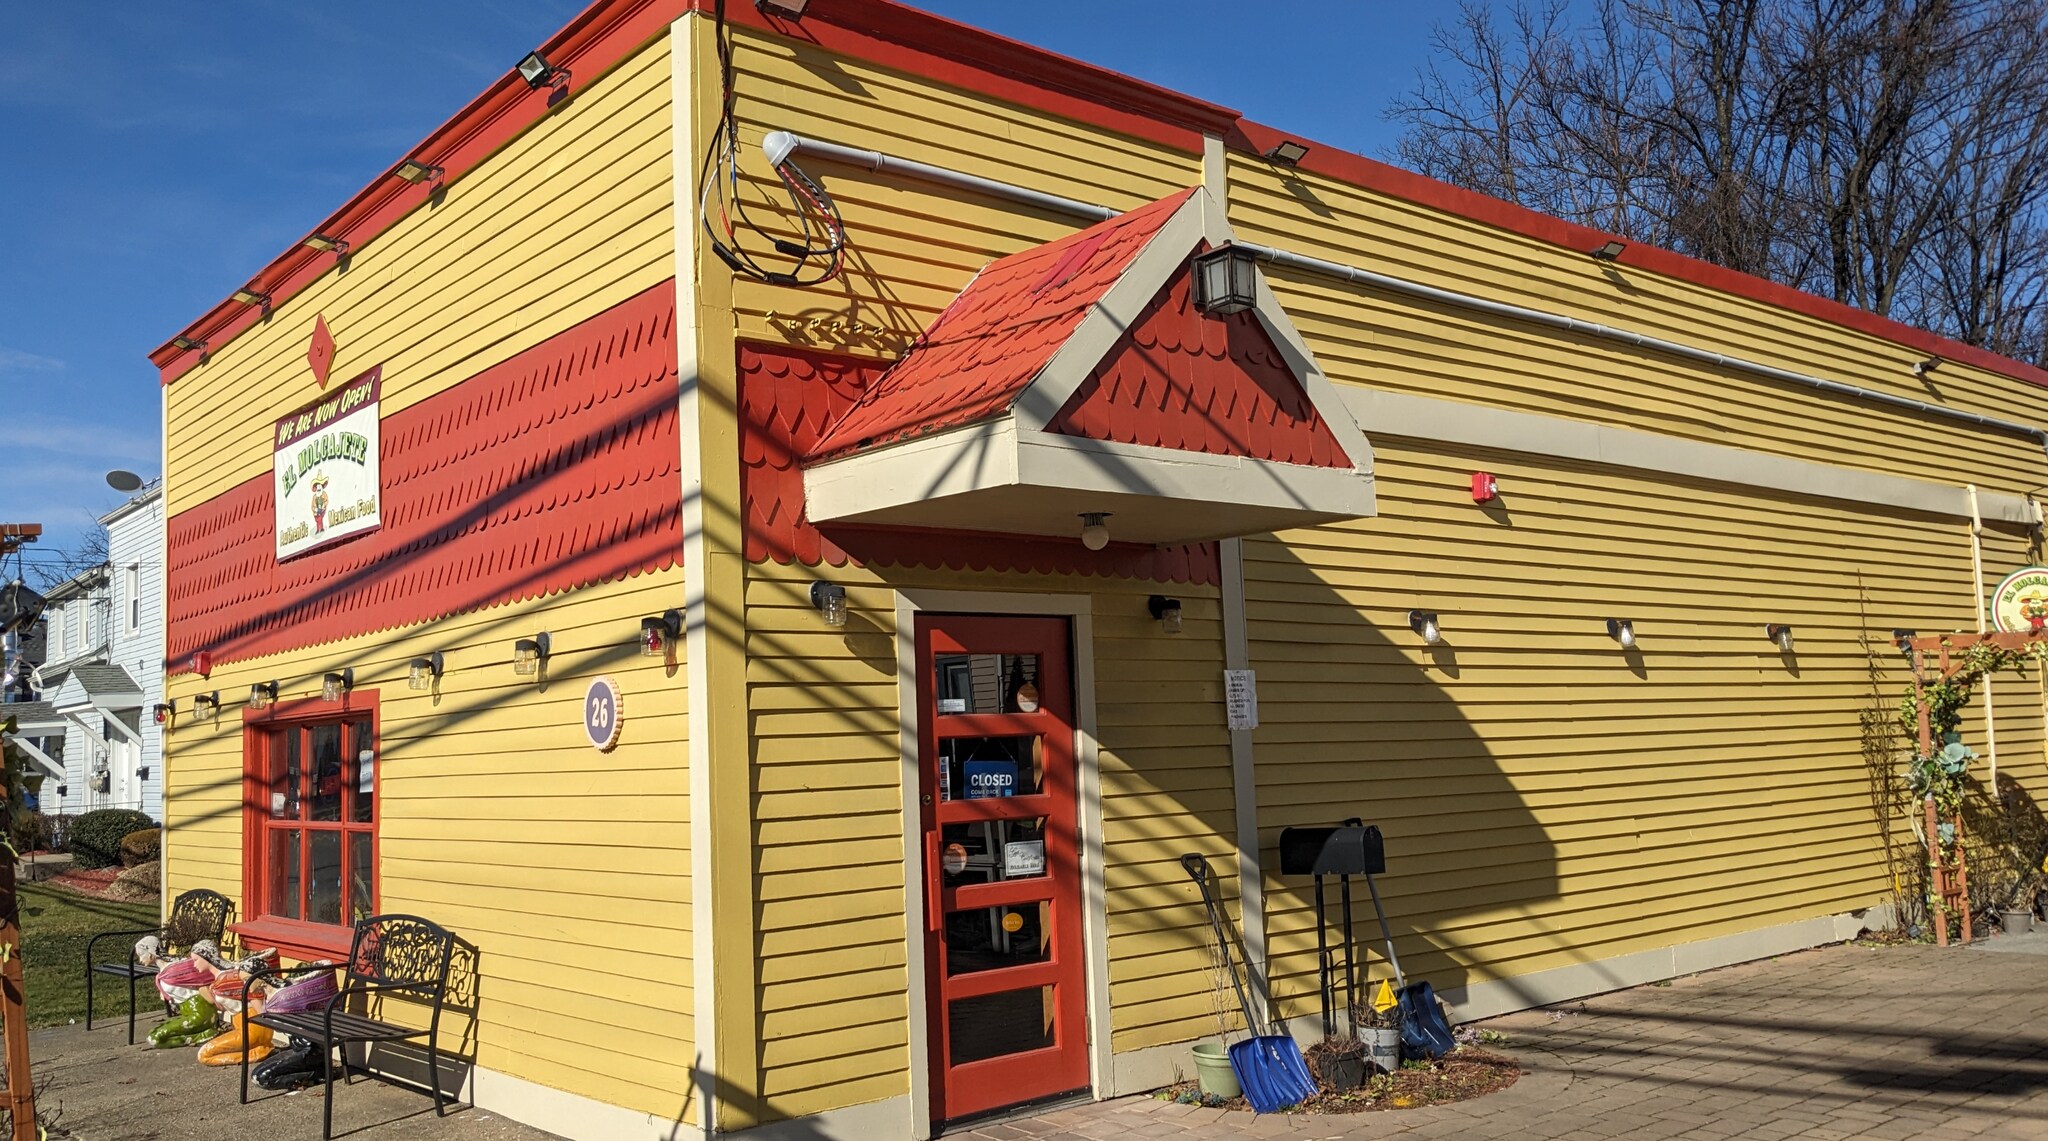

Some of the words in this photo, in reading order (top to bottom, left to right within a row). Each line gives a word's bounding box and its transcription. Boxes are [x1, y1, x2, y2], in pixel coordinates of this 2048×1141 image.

[282, 464, 297, 498] EL
[298, 432, 368, 478] MOLCAJETE
[280, 520, 309, 547] Authentic
[328, 505, 356, 528] Mexican
[357, 494, 376, 518] Food
[2002, 590, 2016, 603] EL
[592, 697, 608, 728] 26
[971, 774, 1013, 786] CLOSED
